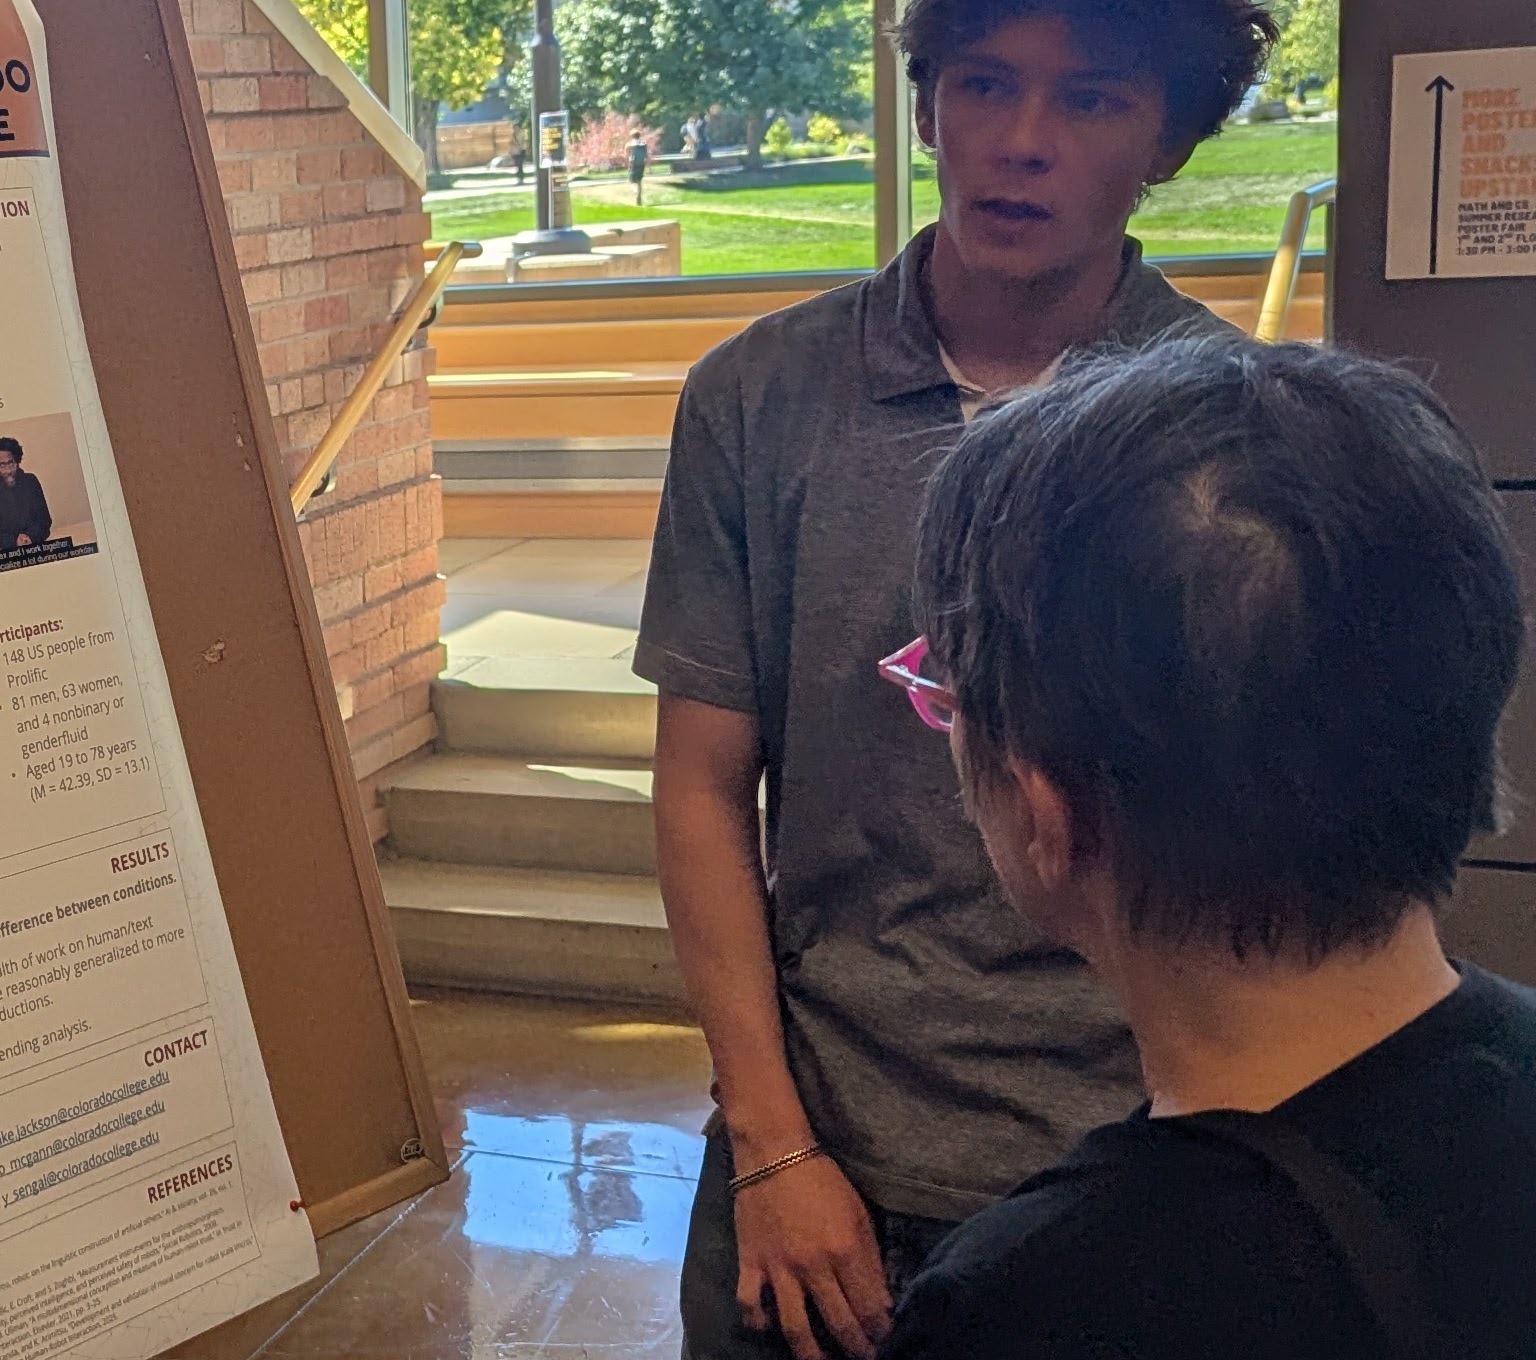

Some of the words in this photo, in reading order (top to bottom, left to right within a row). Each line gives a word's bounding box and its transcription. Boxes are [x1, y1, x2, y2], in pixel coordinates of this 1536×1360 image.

[1462, 110, 1536, 131] POSTE
[1460, 155, 1536, 175] SNACK
[1457, 223, 1499, 235] POSTER
[1501, 222, 1526, 233] FAIR
[1473, 234, 1495, 244] AND
[1480, 245, 1496, 255] PM
[2, 648, 25, 666] 148
[26, 643, 44, 660] US
[46, 635, 86, 660] people
[87, 631, 114, 646] from
[110, 841, 169, 874] RESULTS
[55, 893, 110, 919] between
[112, 873, 177, 902] conditions.
[42, 1018, 92, 1046] analysis.
[144, 1029, 207, 1067] CONTACT
[147, 1154, 233, 1204] REFERENCES
